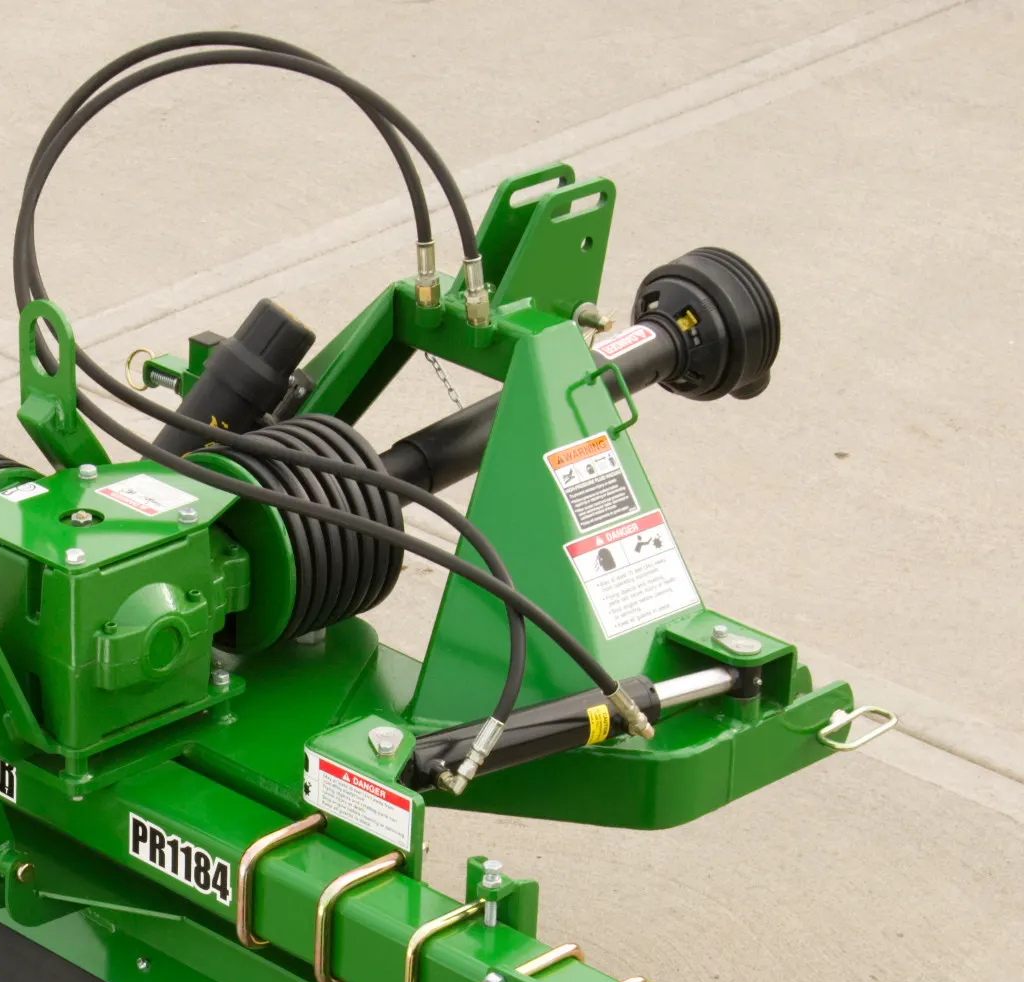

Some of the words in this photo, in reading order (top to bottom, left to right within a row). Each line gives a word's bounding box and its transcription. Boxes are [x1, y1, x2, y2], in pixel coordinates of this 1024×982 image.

[563, 440, 607, 462] WARNING
[604, 522, 640, 542] DANGER
[352, 777, 387, 799] DANGER
[132, 817, 230, 901] PR1184
